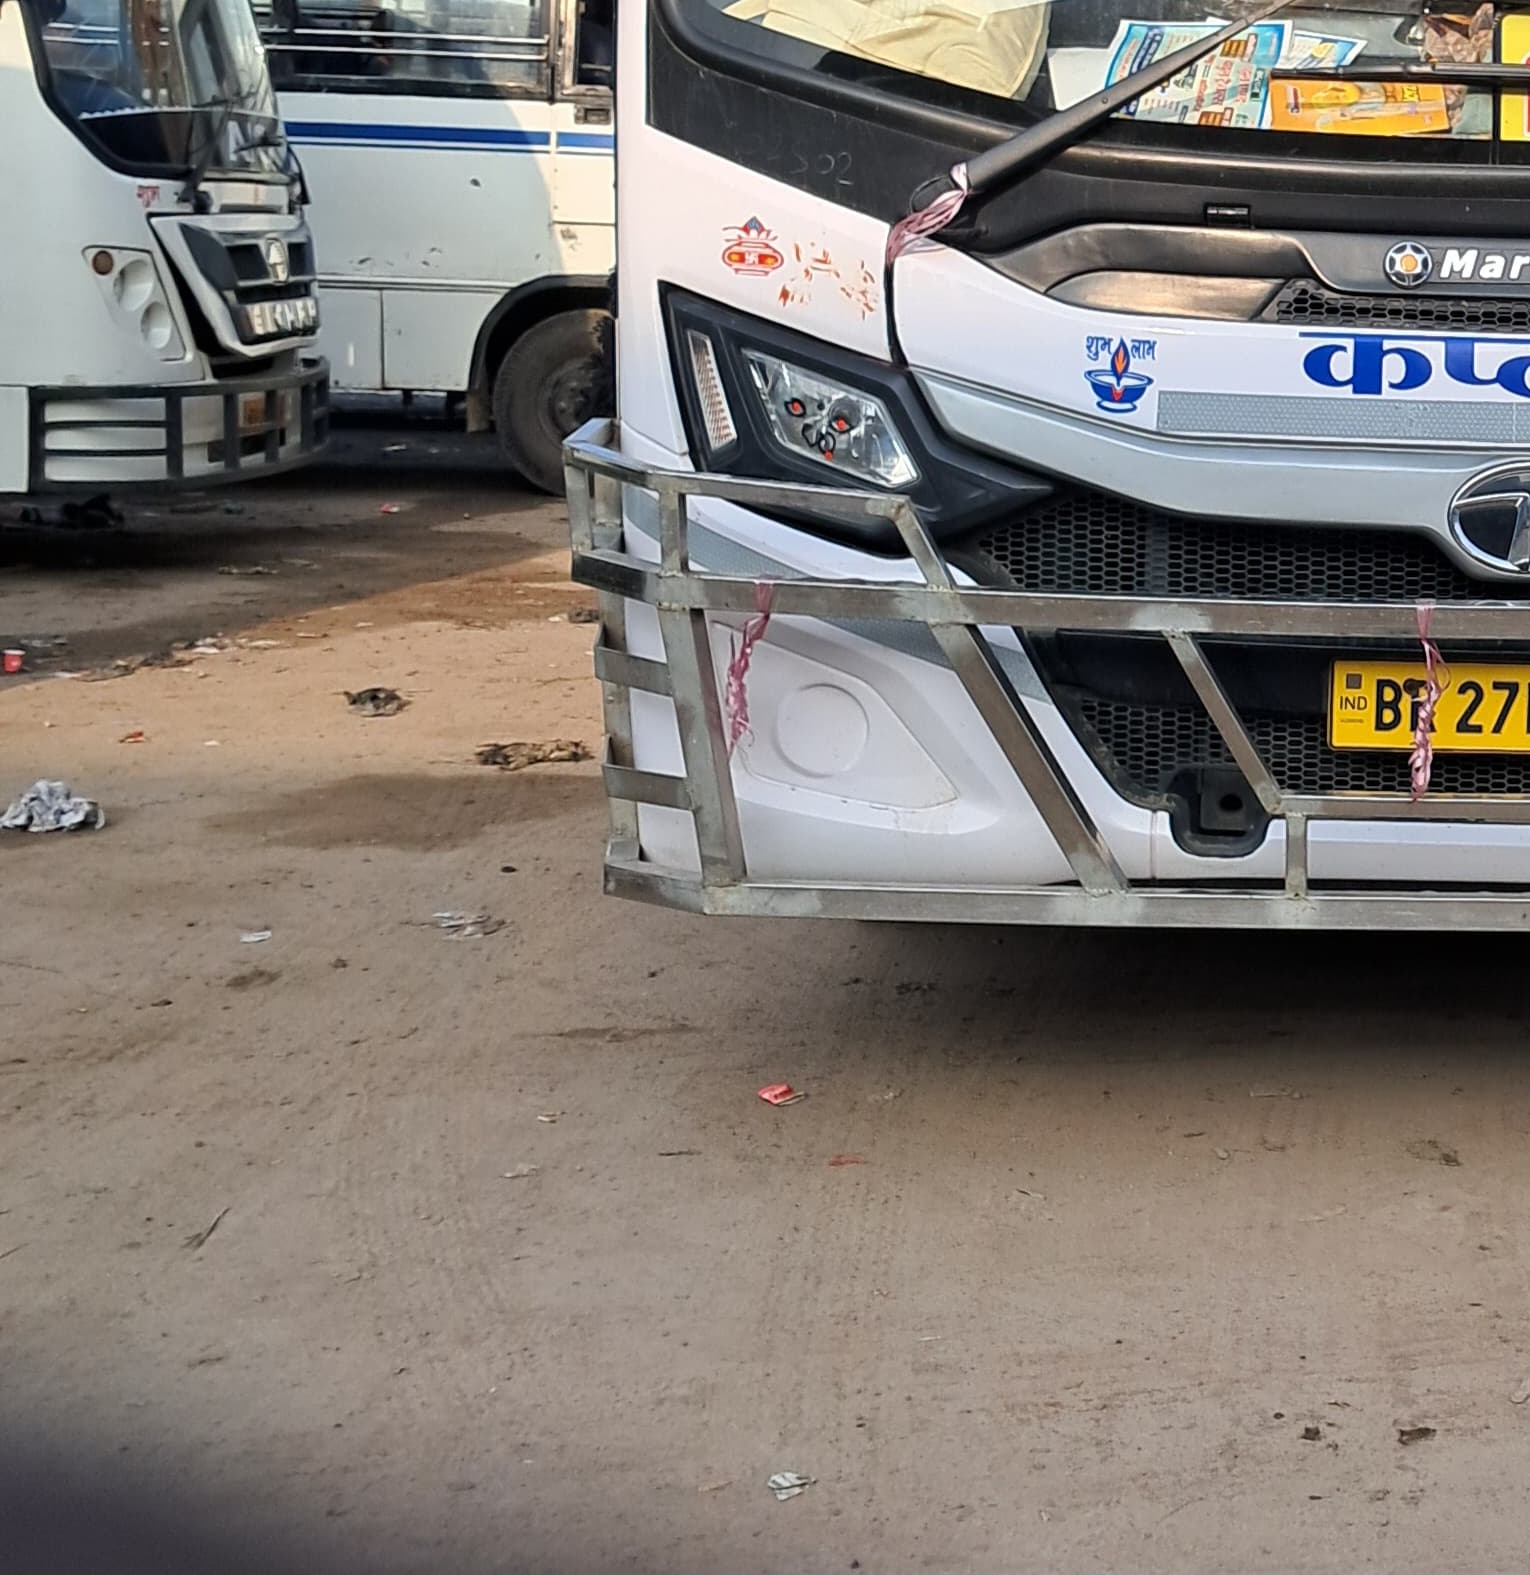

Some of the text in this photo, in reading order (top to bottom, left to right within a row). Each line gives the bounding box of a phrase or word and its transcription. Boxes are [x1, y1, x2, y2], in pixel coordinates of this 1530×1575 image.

[1086, 336, 1157, 361] शुभ लाभ
[1339, 695, 1368, 712] IND
